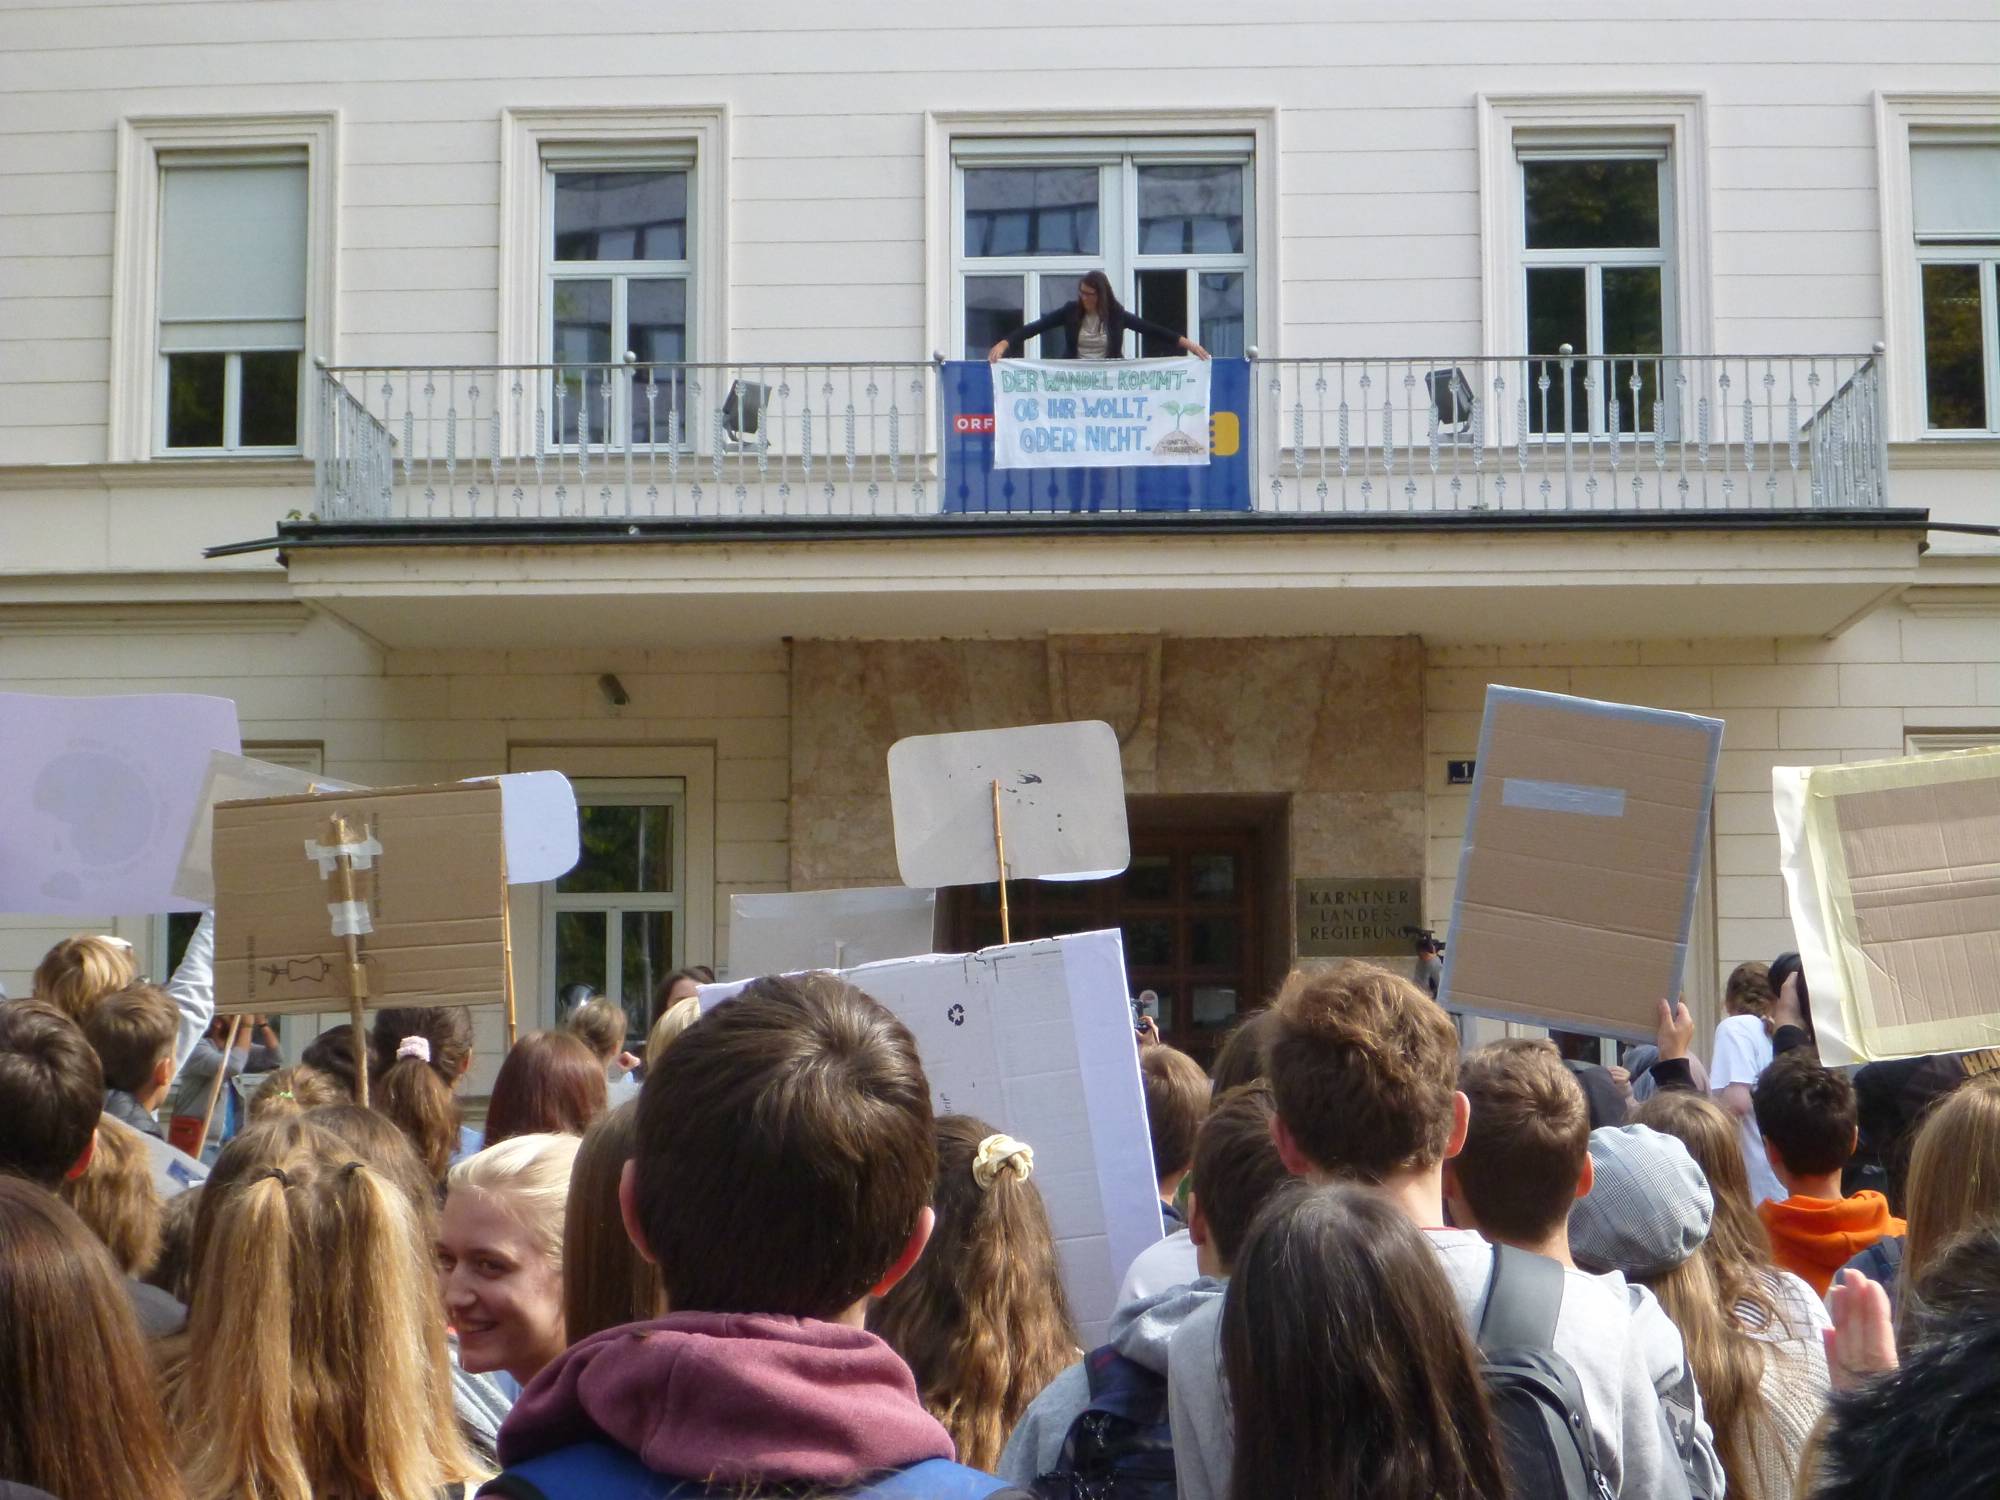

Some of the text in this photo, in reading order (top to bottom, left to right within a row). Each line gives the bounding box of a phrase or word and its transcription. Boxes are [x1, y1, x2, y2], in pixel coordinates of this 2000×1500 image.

[1001, 369, 1038, 393] DER
[1040, 369, 1113, 393] WANDEL
[1013, 396, 1152, 422] OB IHR WOLLT,
[957, 418, 993, 430] ORF
[1020, 425, 1151, 453] ODER NICHT.
[1461, 762, 1469, 777] 1
[1320, 908, 1400, 922] LANDES-
